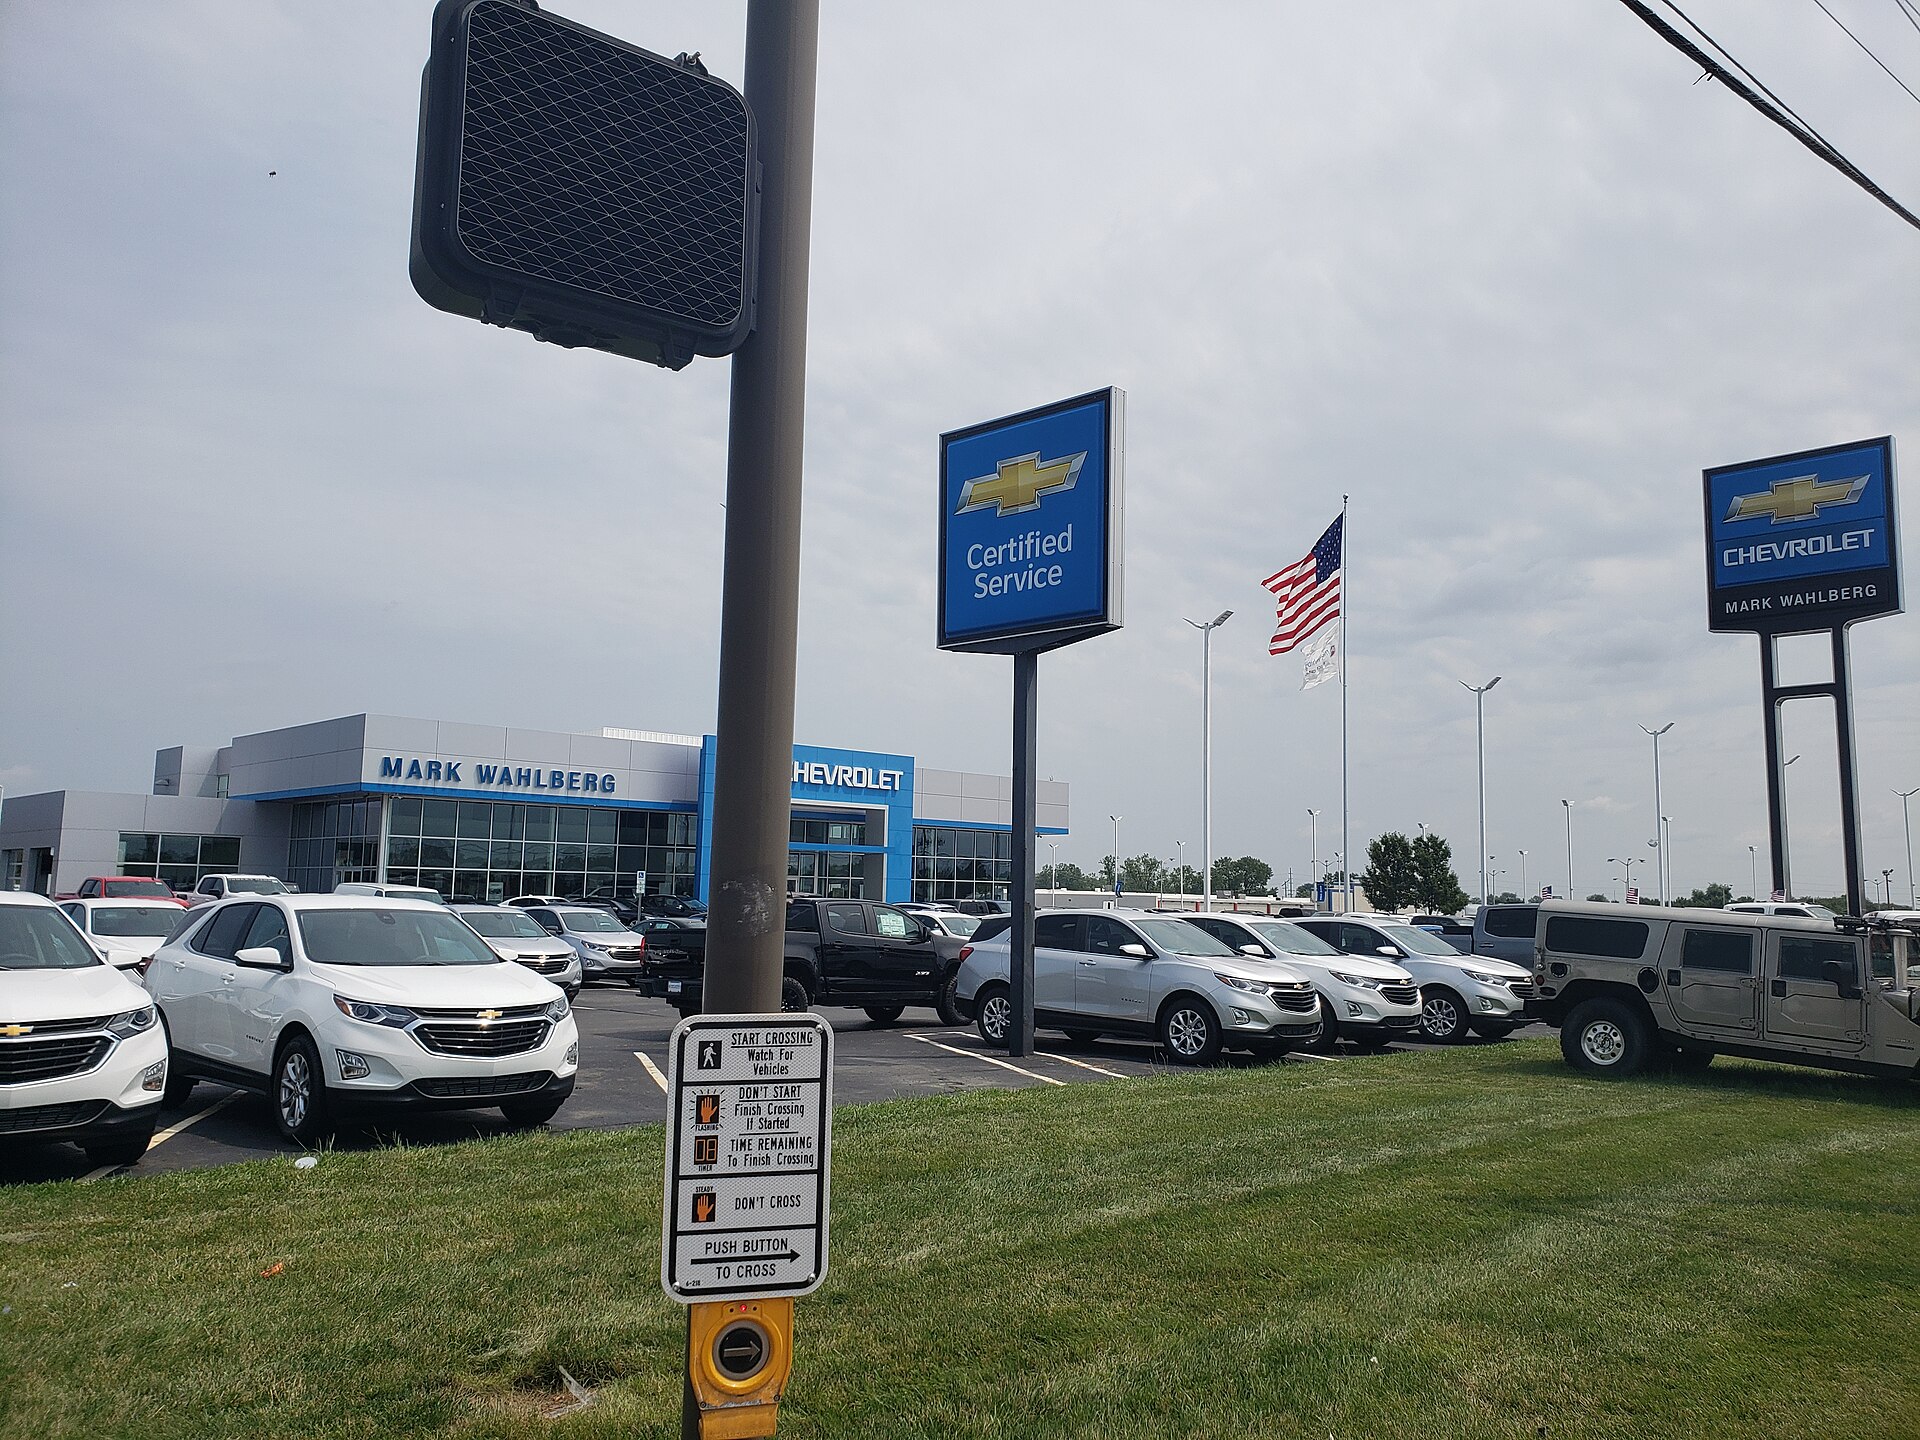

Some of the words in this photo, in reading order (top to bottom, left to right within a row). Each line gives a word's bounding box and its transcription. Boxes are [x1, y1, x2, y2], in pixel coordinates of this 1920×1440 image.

[967, 523, 1073, 570] Certified
[1723, 528, 1875, 567] CHEVROLET
[974, 563, 1063, 599] Service
[1725, 597, 1772, 614] MARK
[1780, 584, 1877, 607] WAHLBERG
[381, 756, 462, 782] MARK
[476, 764, 616, 793] WAHLBERG
[791, 760, 904, 791] HEVROLET
[731, 1032, 760, 1045] START
[765, 1031, 813, 1044] CROSSING
[748, 1048, 774, 1061] Watch
[780, 1048, 794, 1060] For
[753, 1062, 789, 1075] Vehicles
[739, 1086, 768, 1099] DON'T
[773, 1085, 801, 1098] START
[735, 1103, 761, 1116] Finish
[767, 1102, 804, 1117] Crossing
[695, 1123, 719, 1131] FLASHING
[747, 1117, 753, 1130] If
[758, 1116, 789, 1130] Started
[730, 1138, 752, 1151] TIME
[758, 1136, 812, 1150] REMAINING
[728, 1154, 737, 1167] To
[744, 1153, 770, 1166] Finish
[777, 1151, 814, 1167] Crossing
[735, 1196, 764, 1210] DON'T
[770, 1194, 801, 1208] CROSS
[705, 1240, 737, 1254] PUSH
[743, 1238, 788, 1252] BUTTON
[716, 1265, 731, 1279] TO
[737, 1263, 776, 1278] CROSS
